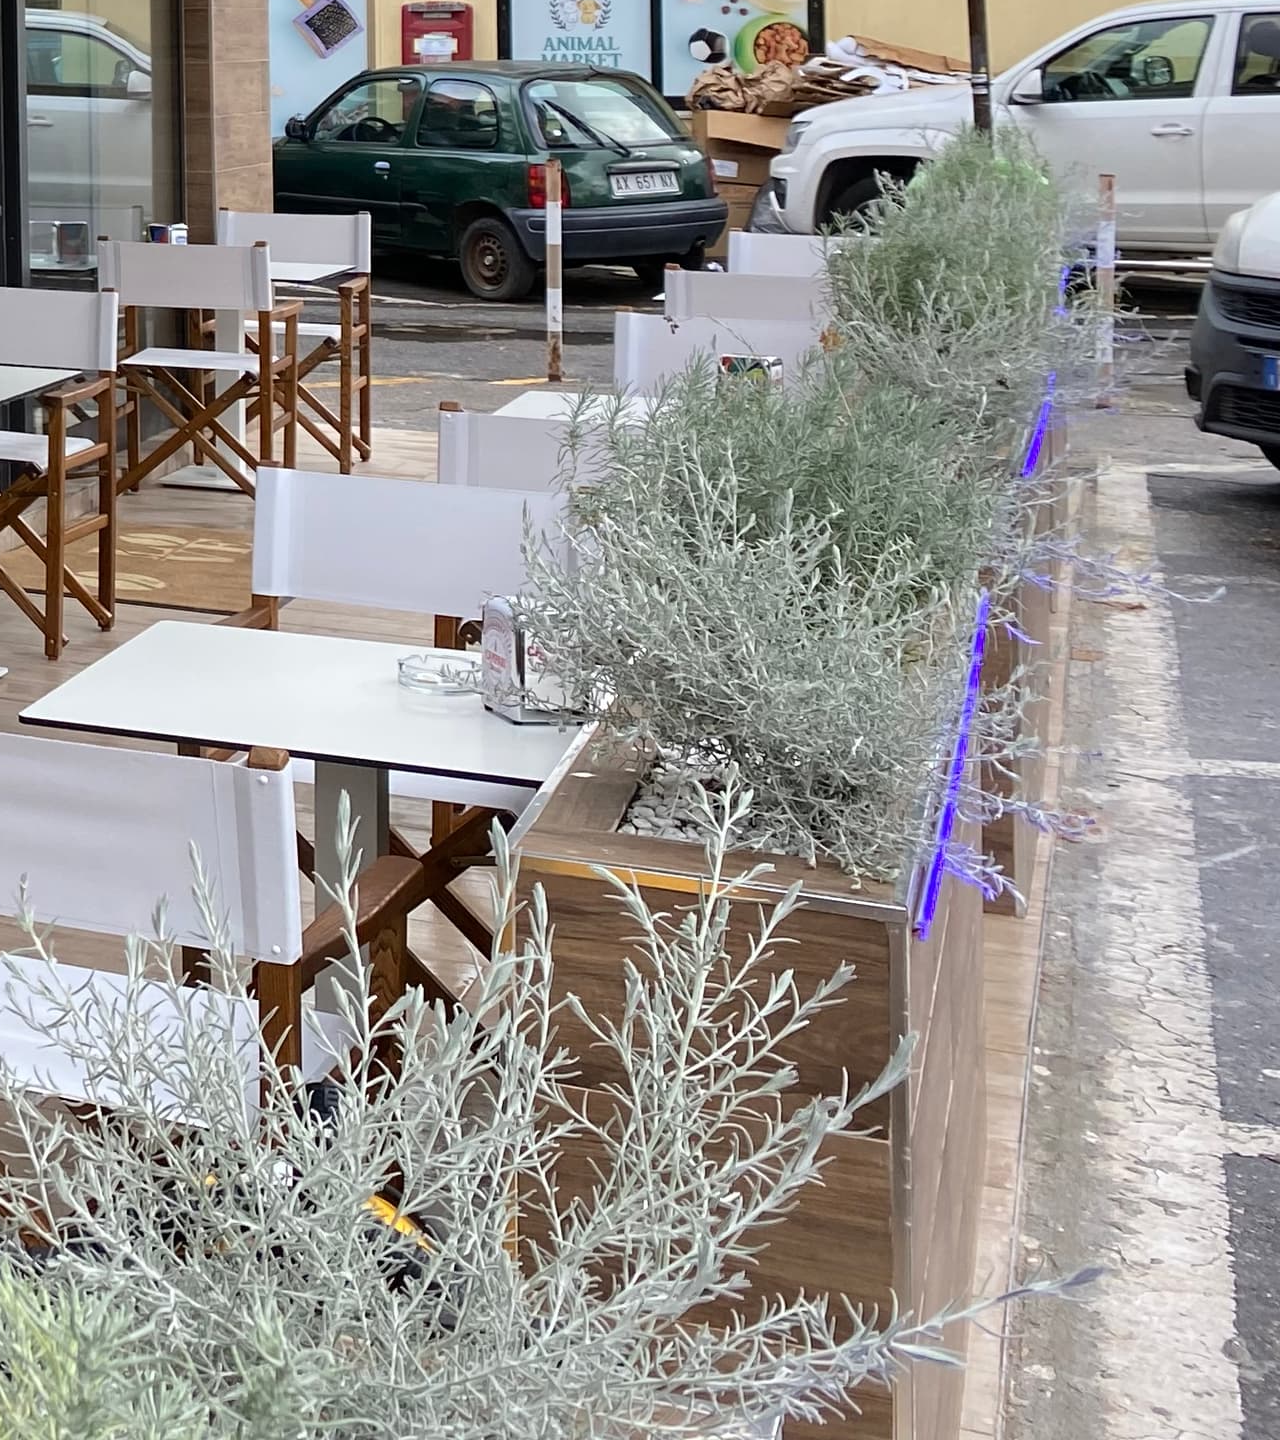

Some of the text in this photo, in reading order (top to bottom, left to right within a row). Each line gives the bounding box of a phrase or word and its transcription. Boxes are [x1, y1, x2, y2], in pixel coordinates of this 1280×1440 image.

[543, 36, 621, 52] ANIMAL
[636, 174, 657, 190] 651
[660, 173, 675, 188] NX
